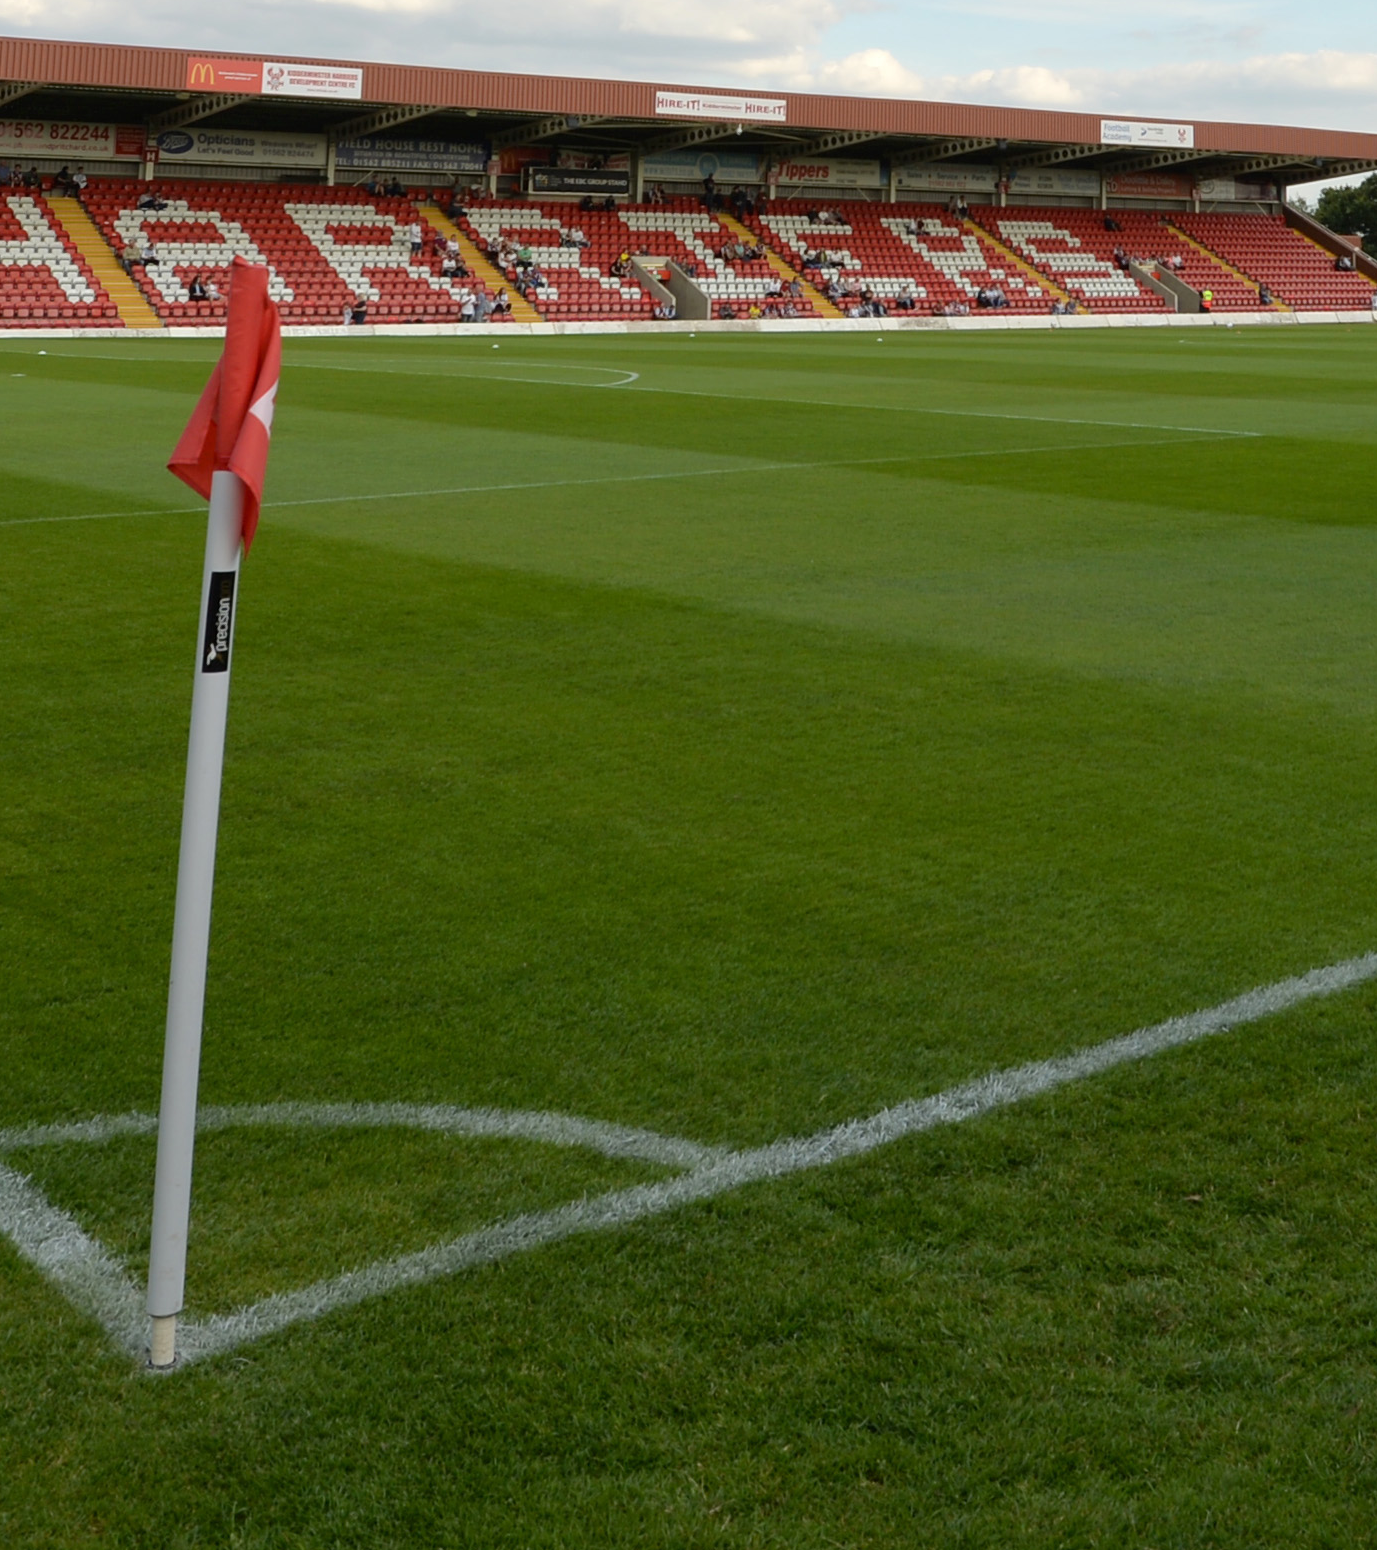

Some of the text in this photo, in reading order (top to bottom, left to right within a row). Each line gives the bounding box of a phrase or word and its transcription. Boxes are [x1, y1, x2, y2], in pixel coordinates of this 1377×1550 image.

[657, 97, 700, 111] HIRE-IT!
[744, 102, 787, 116] HIRE-IT!
[50, 124, 110, 141] 822244
[197, 134, 256, 148] Opticians
[375, 140, 414, 151] HOUSE
[419, 142, 445, 153] REST
[449, 144, 483, 154] HOME
[147, 151, 156, 161] H
[353, 159, 378, 167] 01562
[779, 160, 829, 181] Tippers
[216, 597, 231, 652] precision
